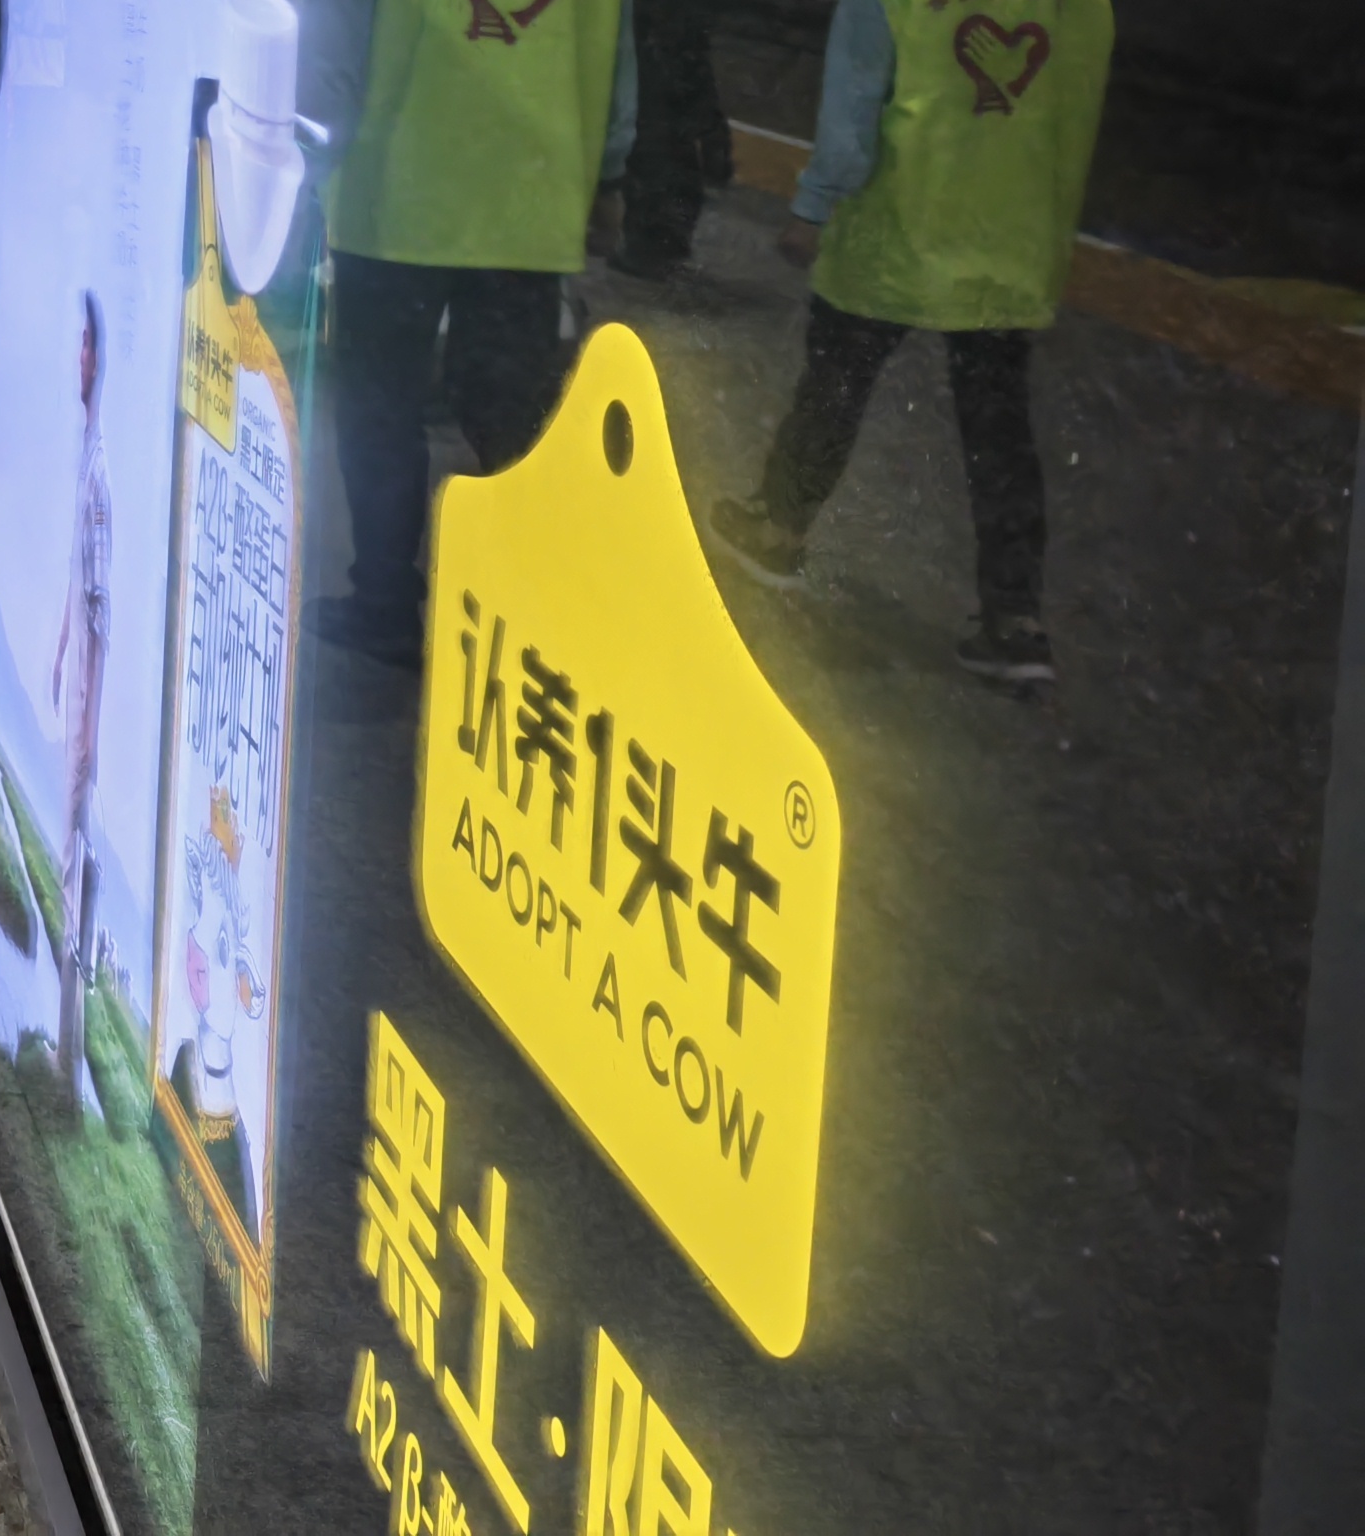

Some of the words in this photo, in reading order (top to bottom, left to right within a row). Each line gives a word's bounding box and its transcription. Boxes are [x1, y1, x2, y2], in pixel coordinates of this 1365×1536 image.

[213, 393, 231, 423] COW
[242, 396, 277, 442] ORGANIC
[239, 423, 287, 506] 黑土限定
[455, 586, 783, 1037] 认养1头牛
[450, 794, 583, 982] ADOPT
[590, 950, 626, 1044] A
[639, 999, 767, 1184] COW
